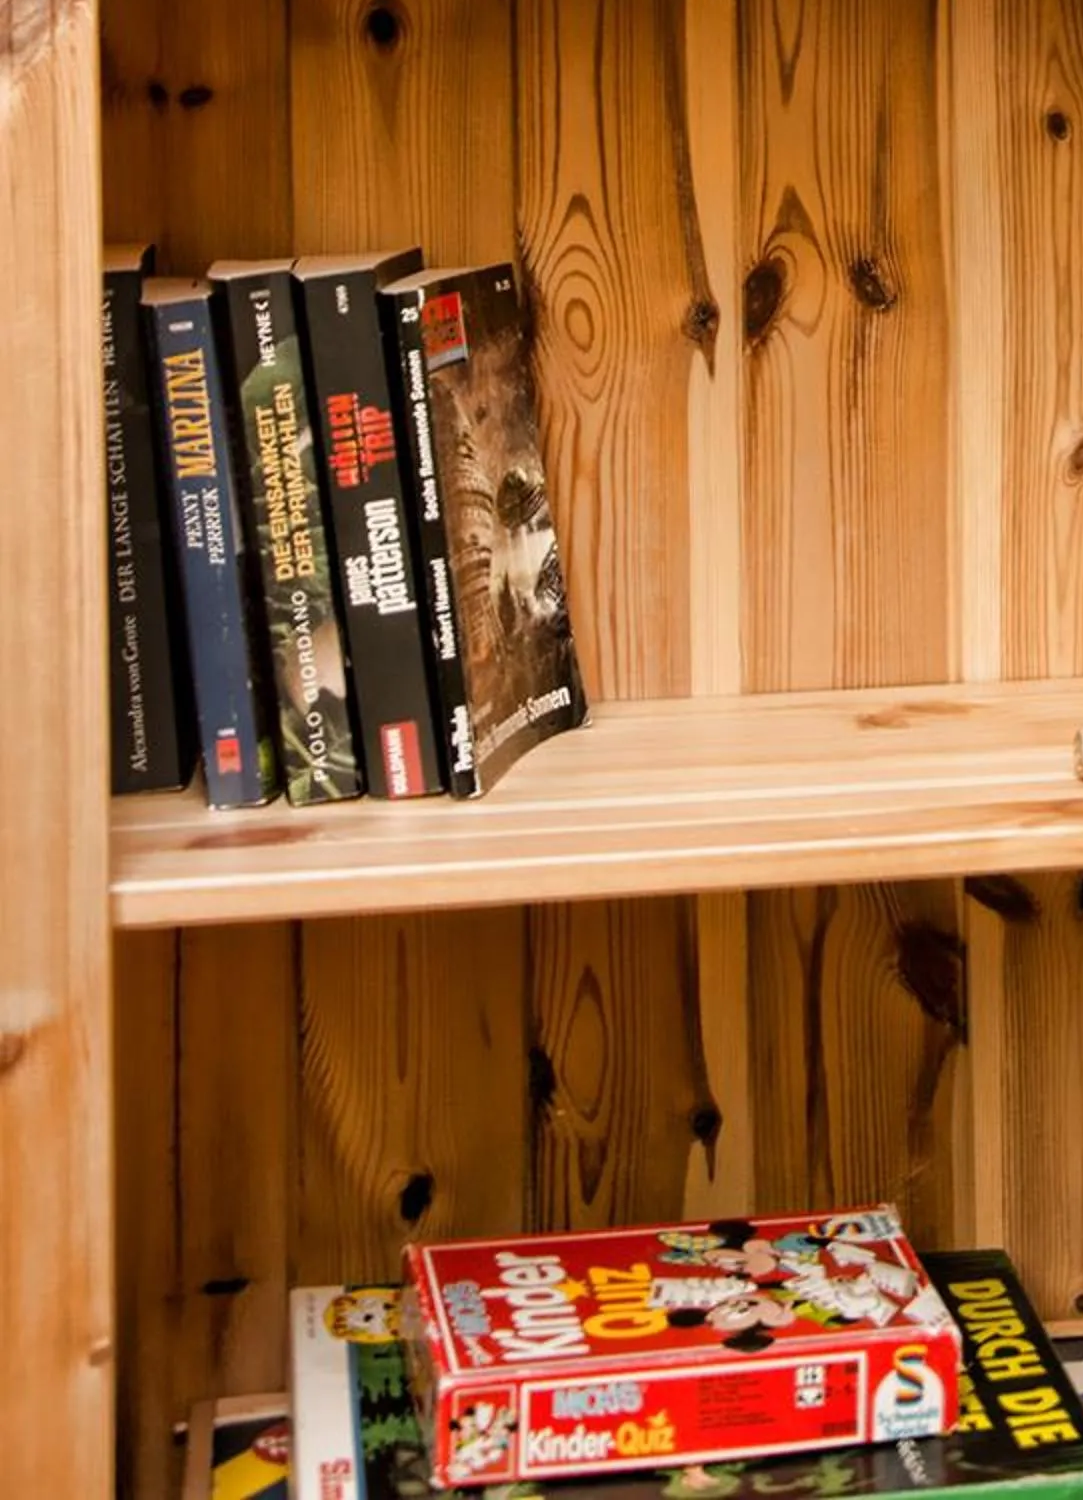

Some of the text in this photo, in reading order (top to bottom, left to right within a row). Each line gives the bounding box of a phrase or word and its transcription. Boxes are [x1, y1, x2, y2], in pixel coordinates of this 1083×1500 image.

[164, 348, 217, 479] MARLINA
[406, 348, 426, 402] Sonnen
[104, 380, 127, 484] SCHATTEN
[256, 405, 295, 581] DIE EINSAMKEIT
[273, 382, 315, 578] DER PRIMZAHLEN
[422, 477, 441, 523] Sechs
[111, 490, 131, 556] LANGE
[181, 489, 204, 549] PENNY
[202, 486, 226, 565] PERRICK
[363, 497, 418, 616] patterson
[116, 562, 137, 602] DER
[345, 554, 377, 607] james
[121, 615, 138, 662] Grote
[127, 662, 142, 693] von
[290, 590, 328, 783] PAOLO GIORDANO
[128, 694, 147, 772] Alexandra
[480, 1251, 592, 1363] Kinder
[582, 1263, 669, 1339] Quiz
[948, 1277, 1048, 1382] DURCH
[997, 1386, 1081, 1449] DIE
